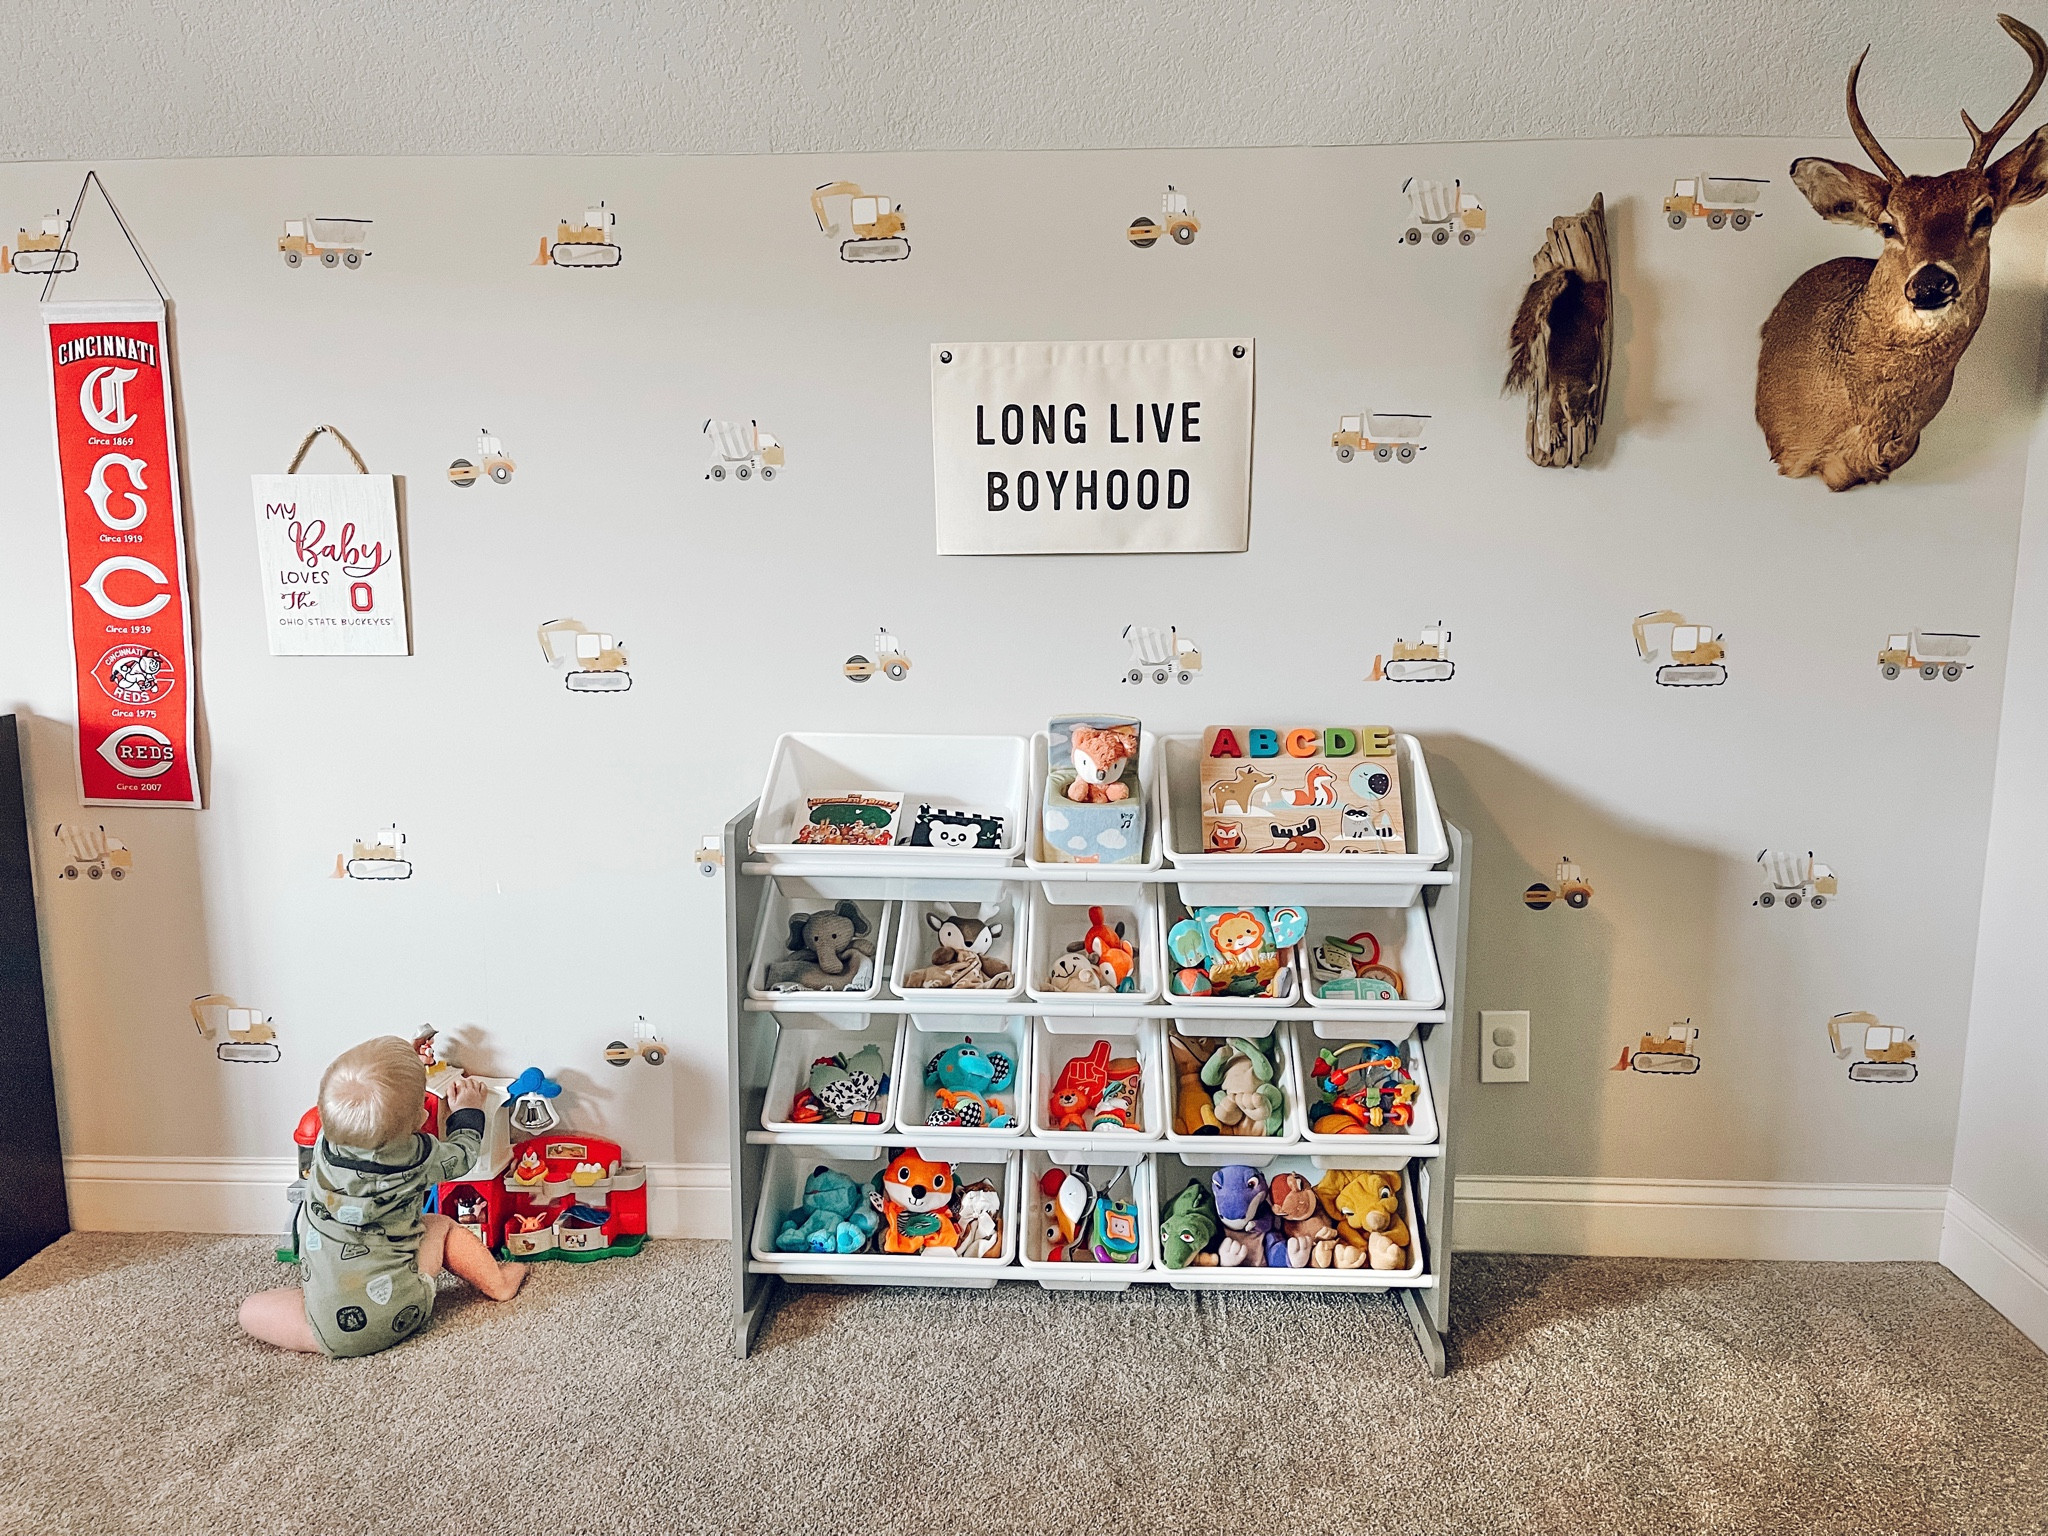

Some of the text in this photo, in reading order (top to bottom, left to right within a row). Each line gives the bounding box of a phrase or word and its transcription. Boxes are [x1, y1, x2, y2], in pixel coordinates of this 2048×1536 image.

[58, 335, 156, 366] CINCINNATI
[976, 401, 1201, 445] LONG LIVE
[88, 437, 134, 446] Circa 1869
[987, 469, 1190, 512] BOYHOOD
[99, 534, 143, 543] Circa 1919
[288, 519, 392, 578] Baby
[280, 571, 330, 584] LOVES
[80, 555, 171, 620] C
[280, 591, 319, 610] The
[105, 625, 151, 634] Circa 1939
[279, 618, 391, 626] OHIO STATE BUCKEYES
[105, 648, 143, 666] CINCINNATI
[113, 686, 150, 702] REDS
[111, 709, 157, 718] Circa 1975
[120, 745, 174, 760] REDS
[116, 783, 162, 791] Circa 2007
